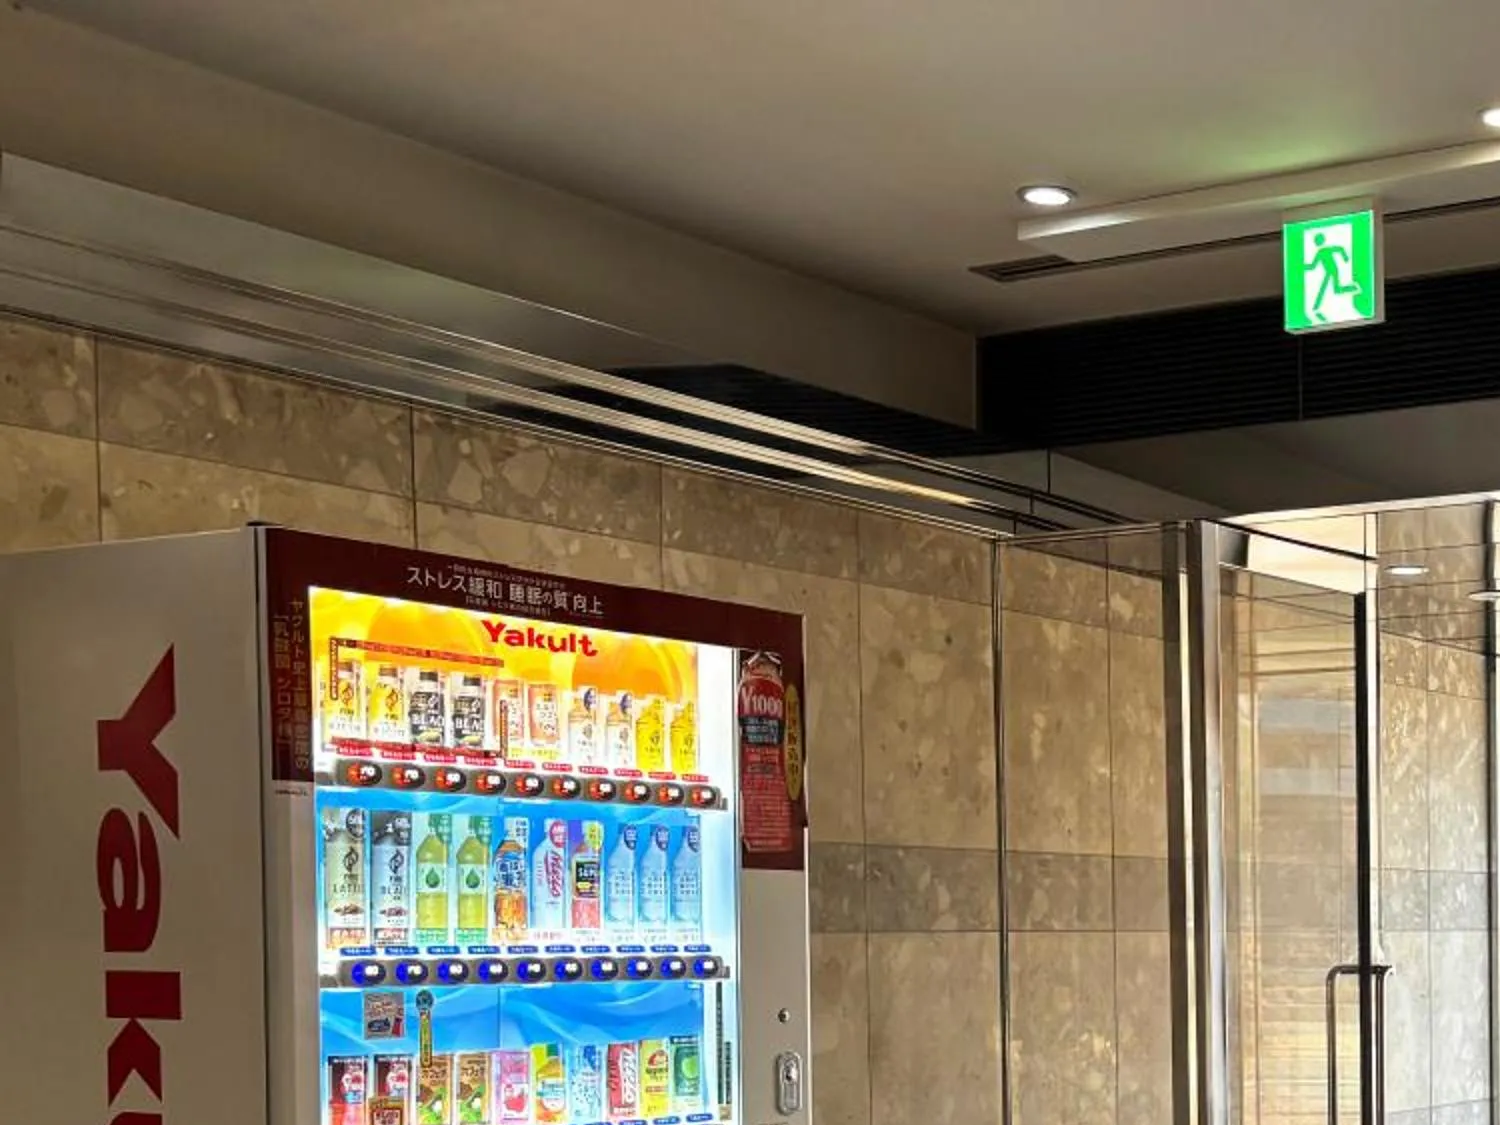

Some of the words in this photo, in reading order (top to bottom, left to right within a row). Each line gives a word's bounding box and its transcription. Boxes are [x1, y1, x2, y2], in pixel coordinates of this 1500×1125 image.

[406, 566, 503, 600] ストレス緩和
[572, 593, 605, 615] 向上
[481, 619, 599, 657] Yakult
